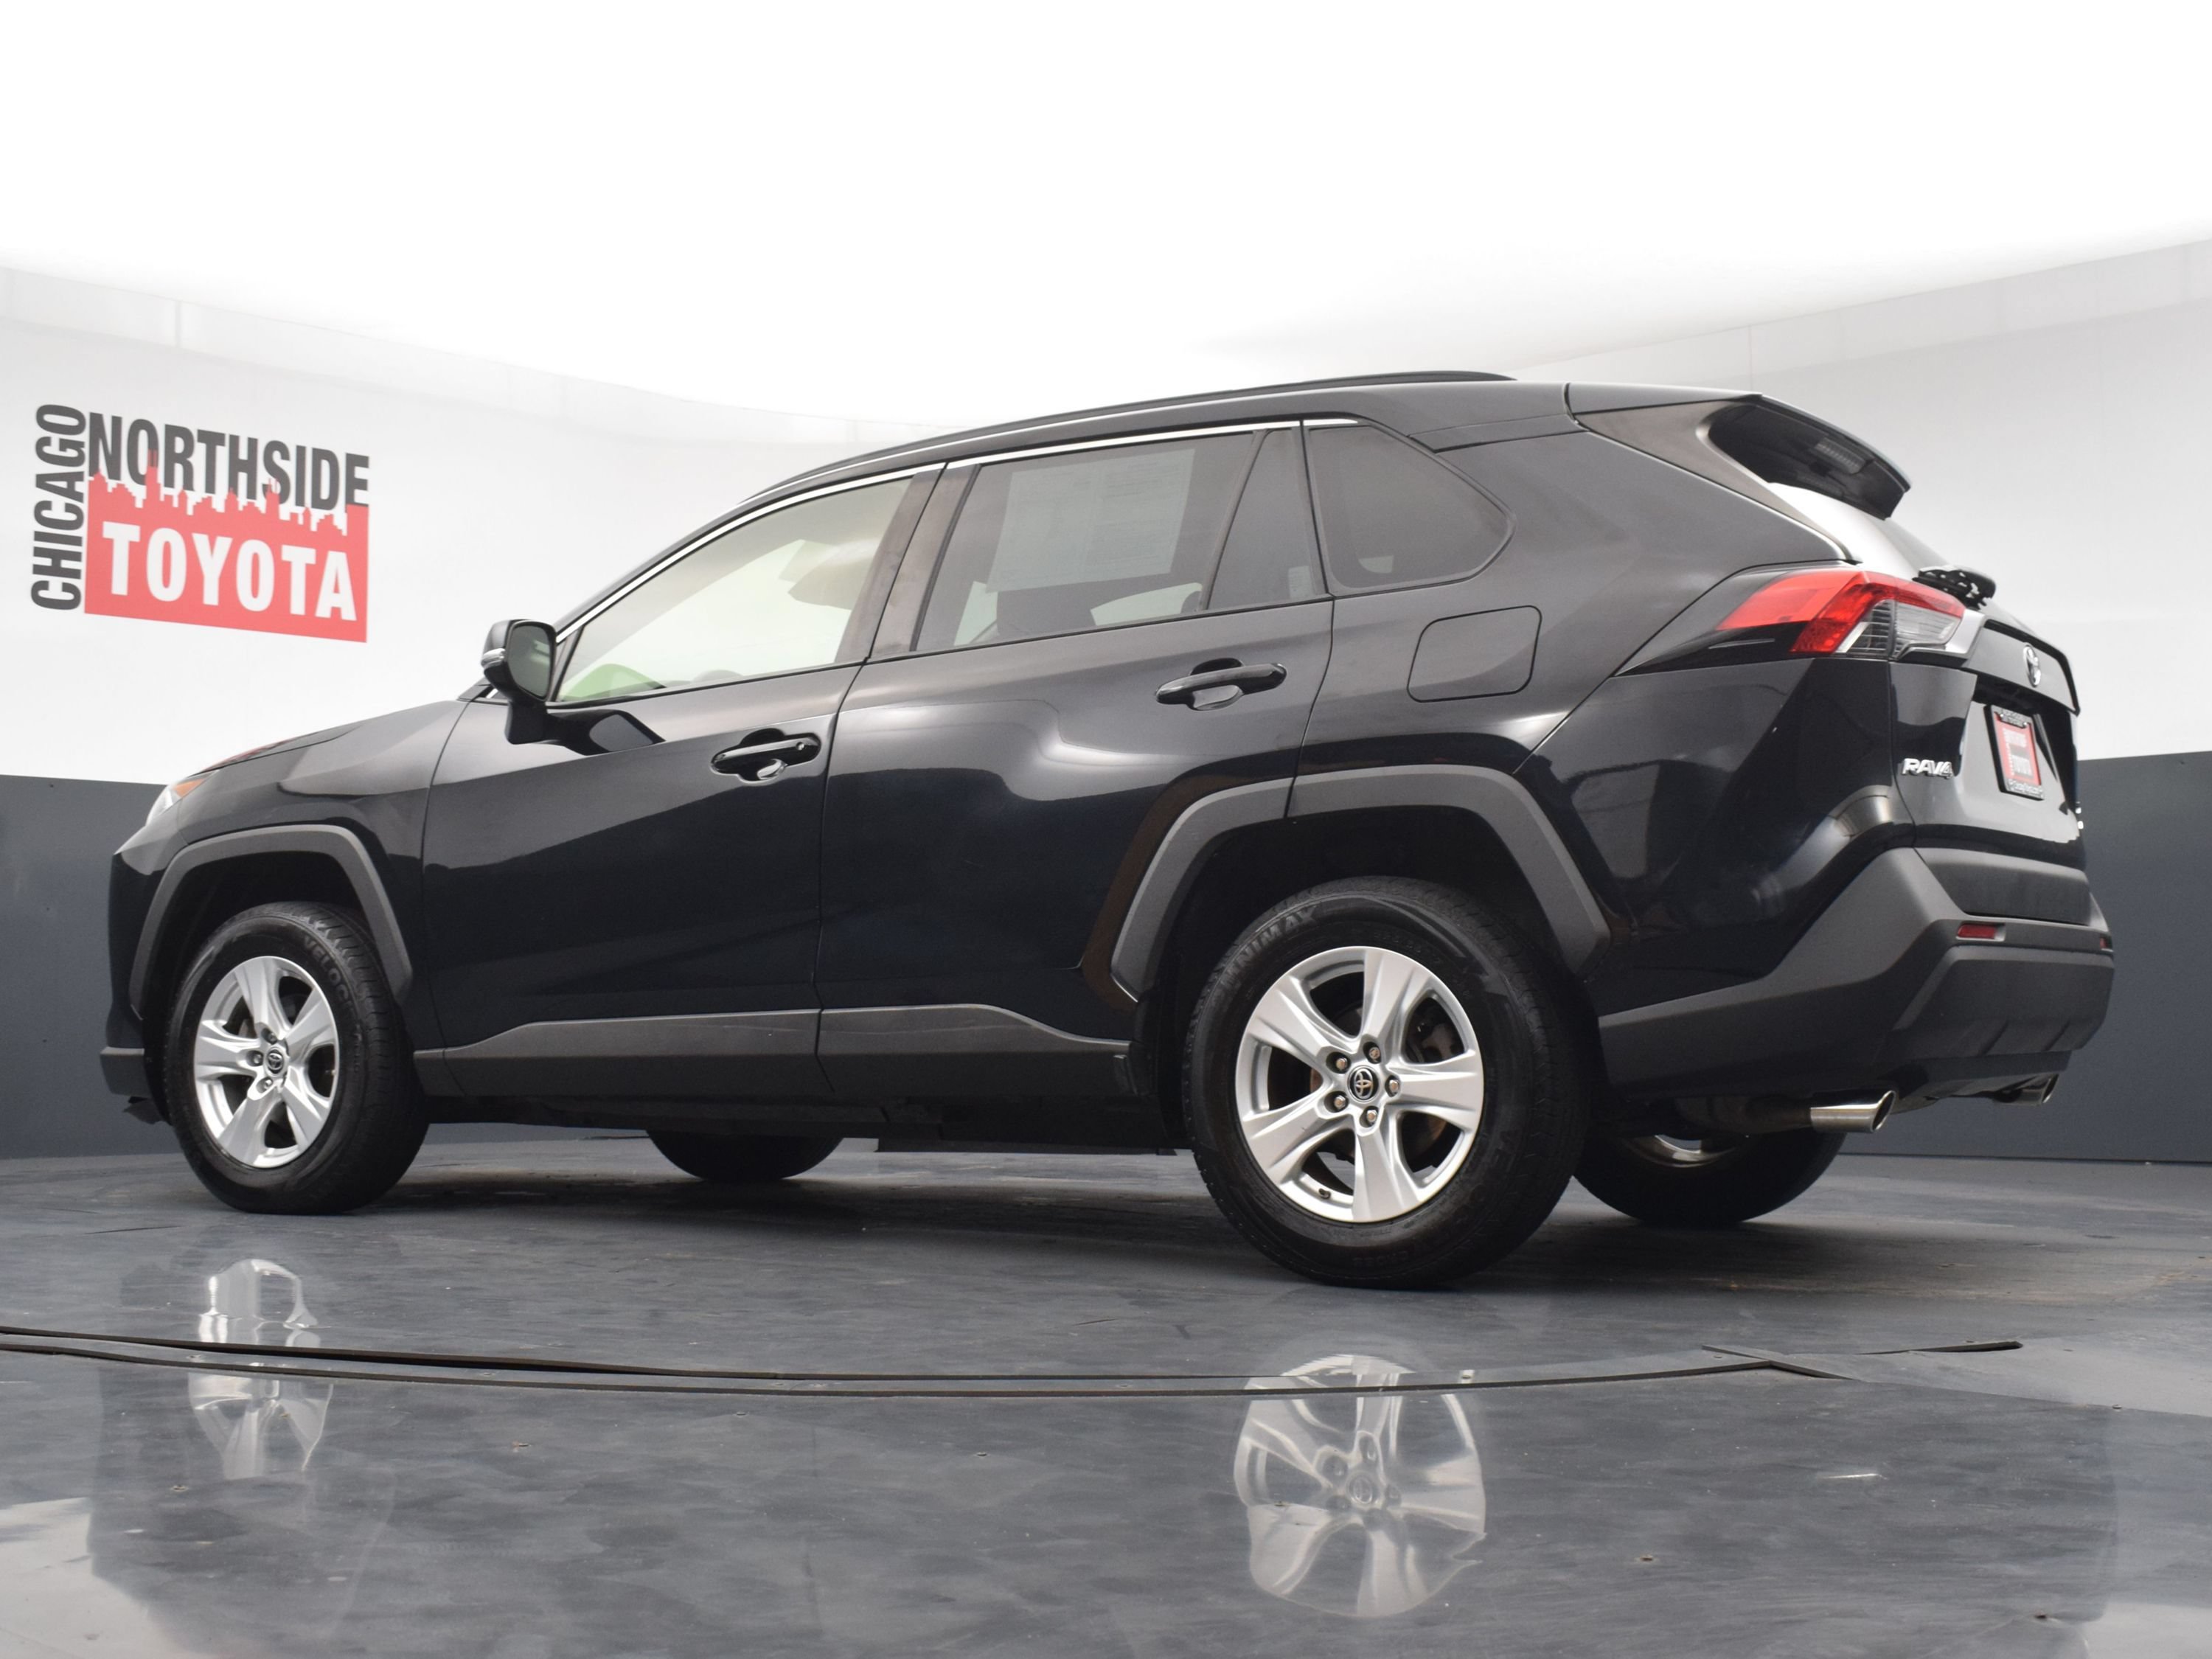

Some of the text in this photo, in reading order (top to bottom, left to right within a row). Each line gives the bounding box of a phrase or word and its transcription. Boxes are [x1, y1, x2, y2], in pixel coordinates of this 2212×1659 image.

[31, 404, 86, 611] CHICAGO
[88, 411, 369, 511] NORTHSIDE
[102, 521, 357, 622] TOYOTA
[1902, 758, 1953, 779] RAV4
